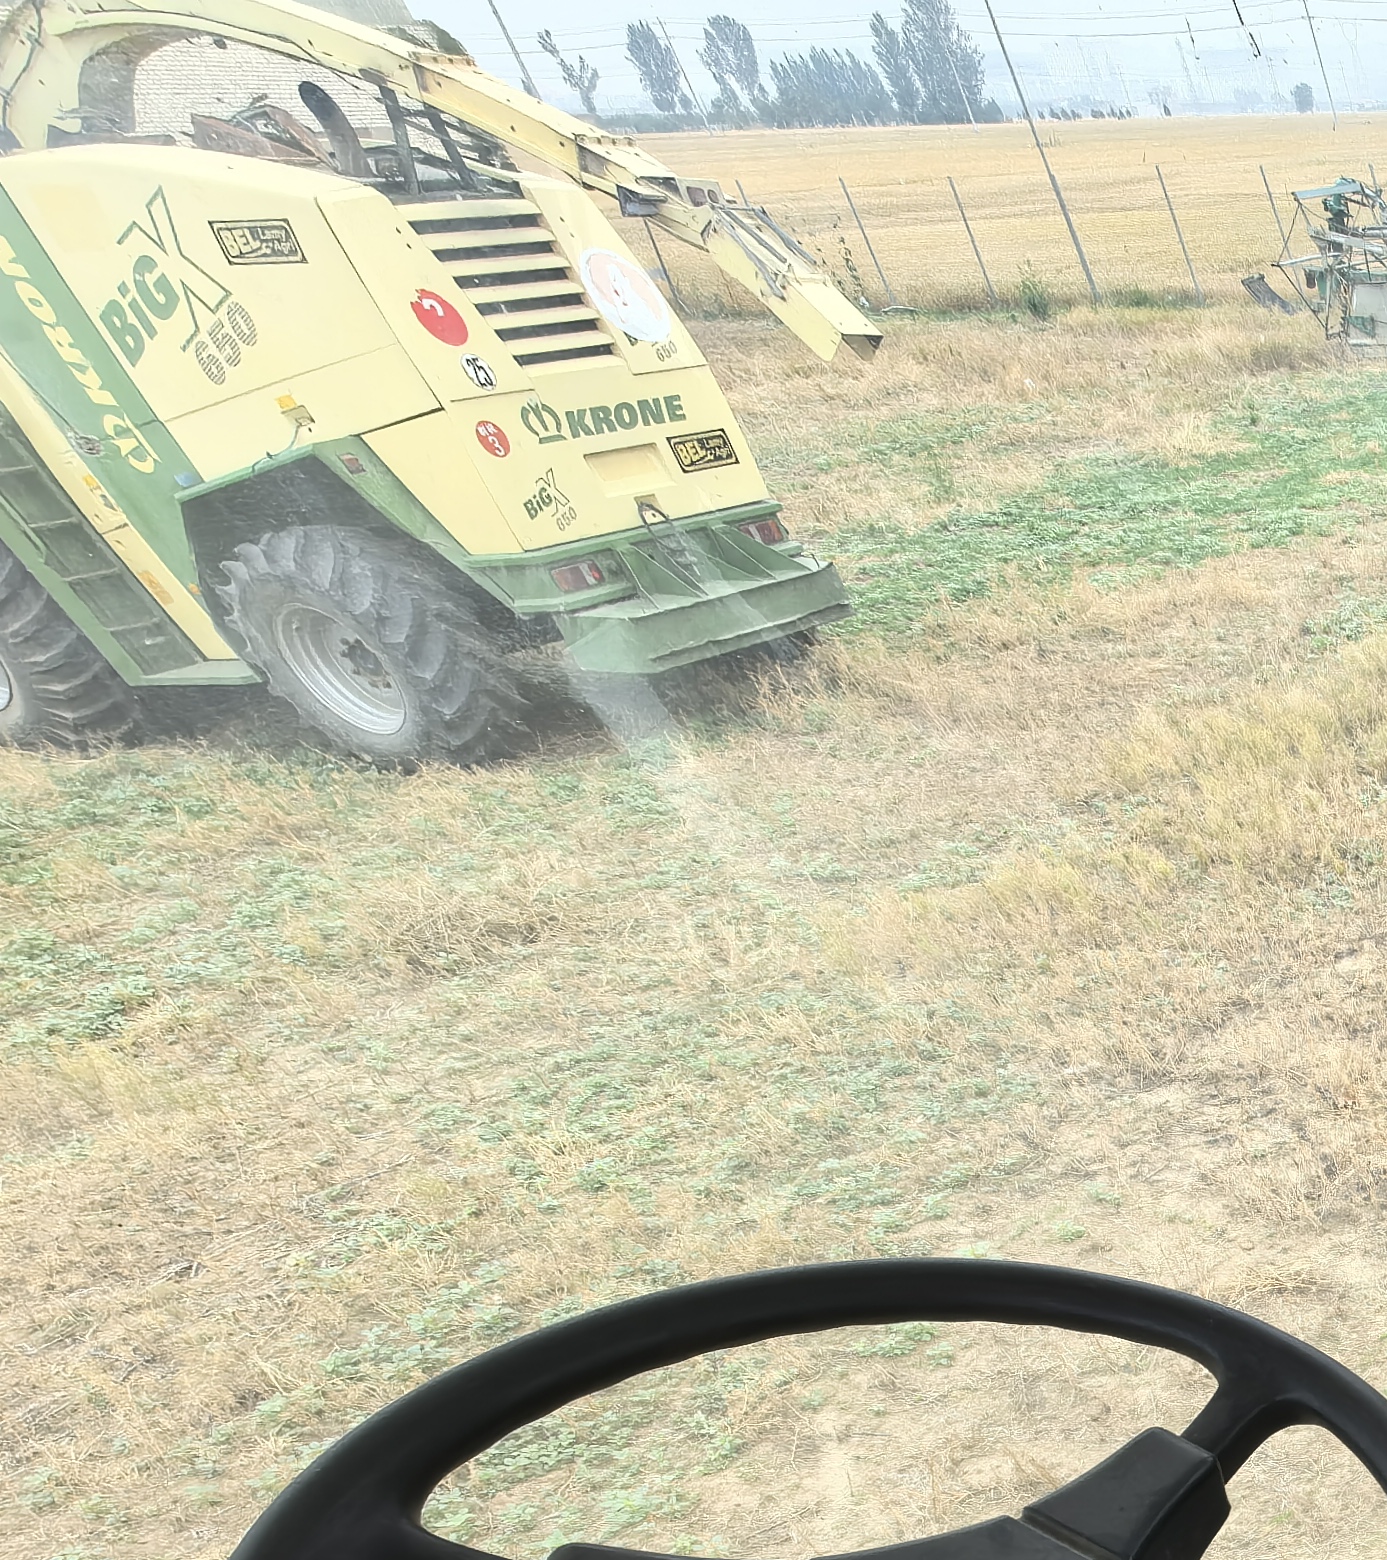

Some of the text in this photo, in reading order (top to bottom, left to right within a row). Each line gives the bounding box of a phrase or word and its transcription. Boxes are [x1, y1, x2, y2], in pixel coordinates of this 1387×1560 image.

[465, 357, 494, 388] 25
[565, 394, 687, 439] KRONE
[488, 436, 506, 457] 3
